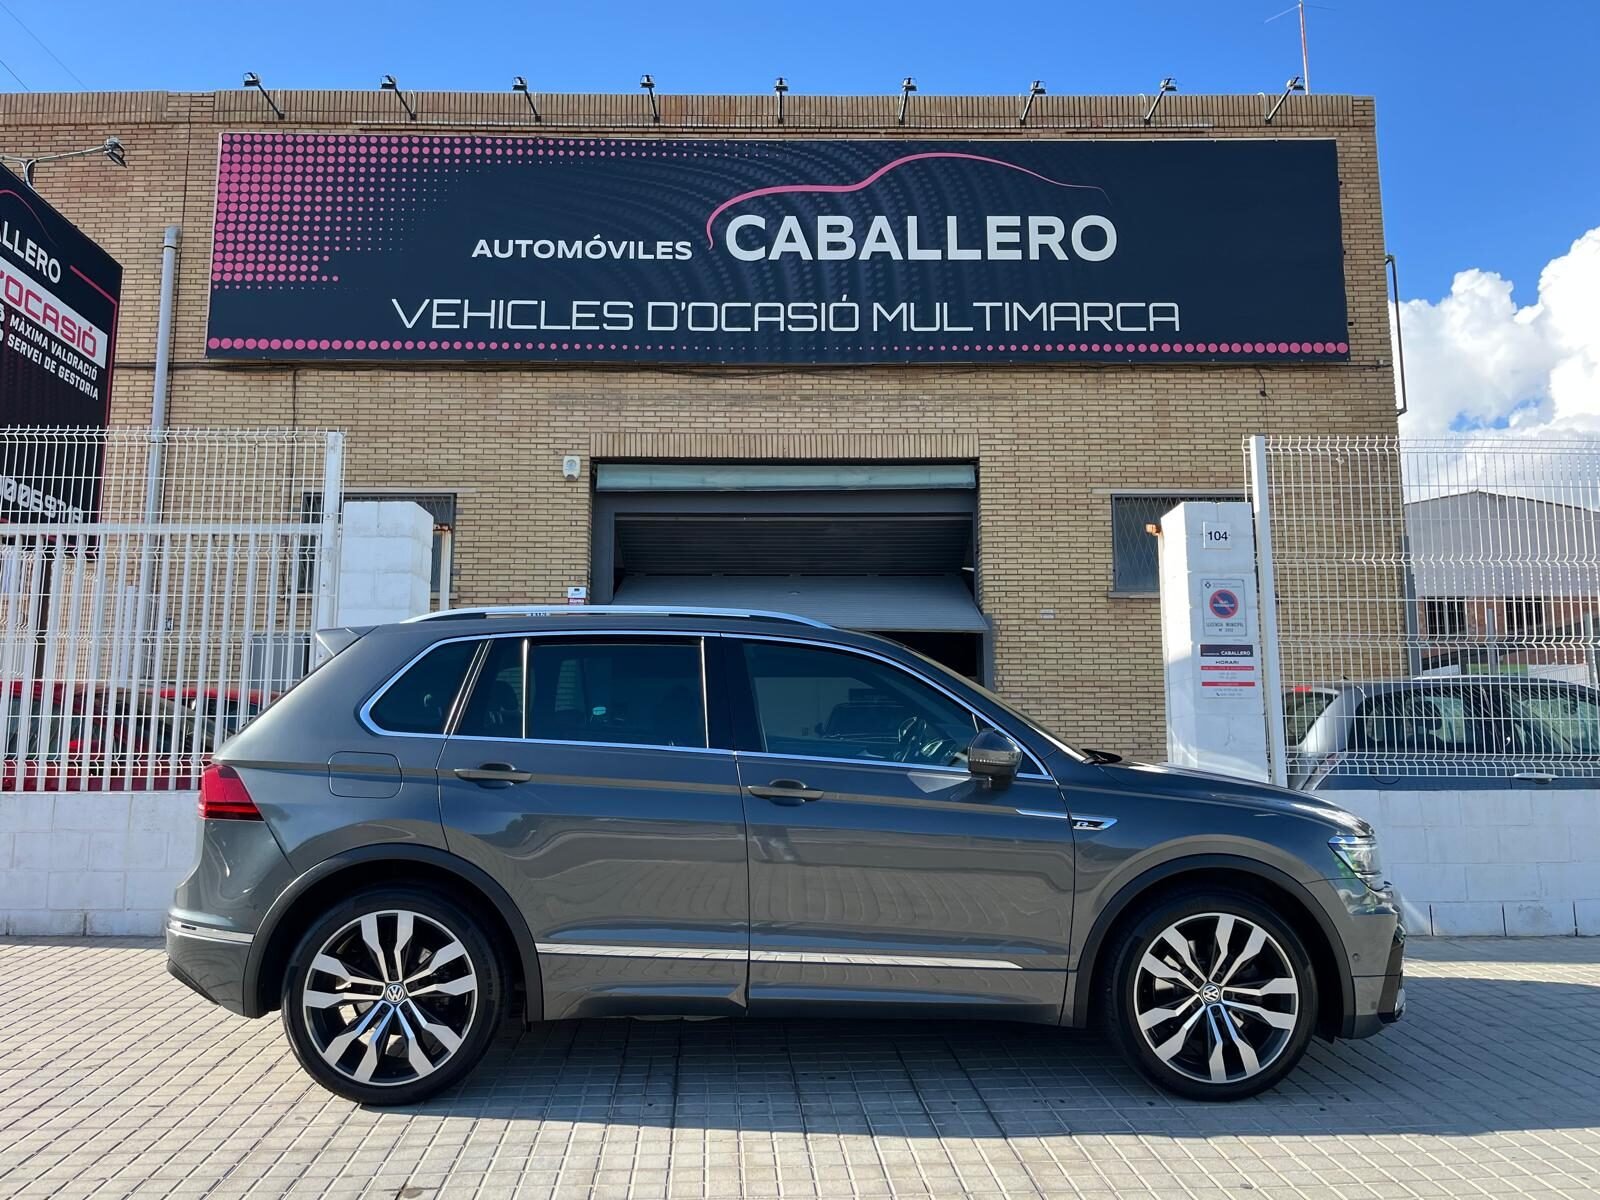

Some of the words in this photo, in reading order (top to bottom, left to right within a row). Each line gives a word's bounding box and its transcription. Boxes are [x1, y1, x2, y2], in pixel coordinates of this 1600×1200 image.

[0, 220, 62, 285] LLERO
[471, 234, 693, 261] AUTOMÓVILES
[725, 214, 1118, 262] CABALLERO
[391, 298, 634, 331] VEHICLES
[647, 295, 859, 332] D'OCASIÓ
[872, 302, 1180, 332] MULTIMARCA
[7, 333, 42, 365] SERVEI
[43, 356, 57, 374] DE
[57, 365, 99, 401] GESTORIA
[9, 314, 49, 350] MÀXIMA
[51, 341, 98, 381] VALORACIÓ
[1207, 531, 1229, 541] 104
